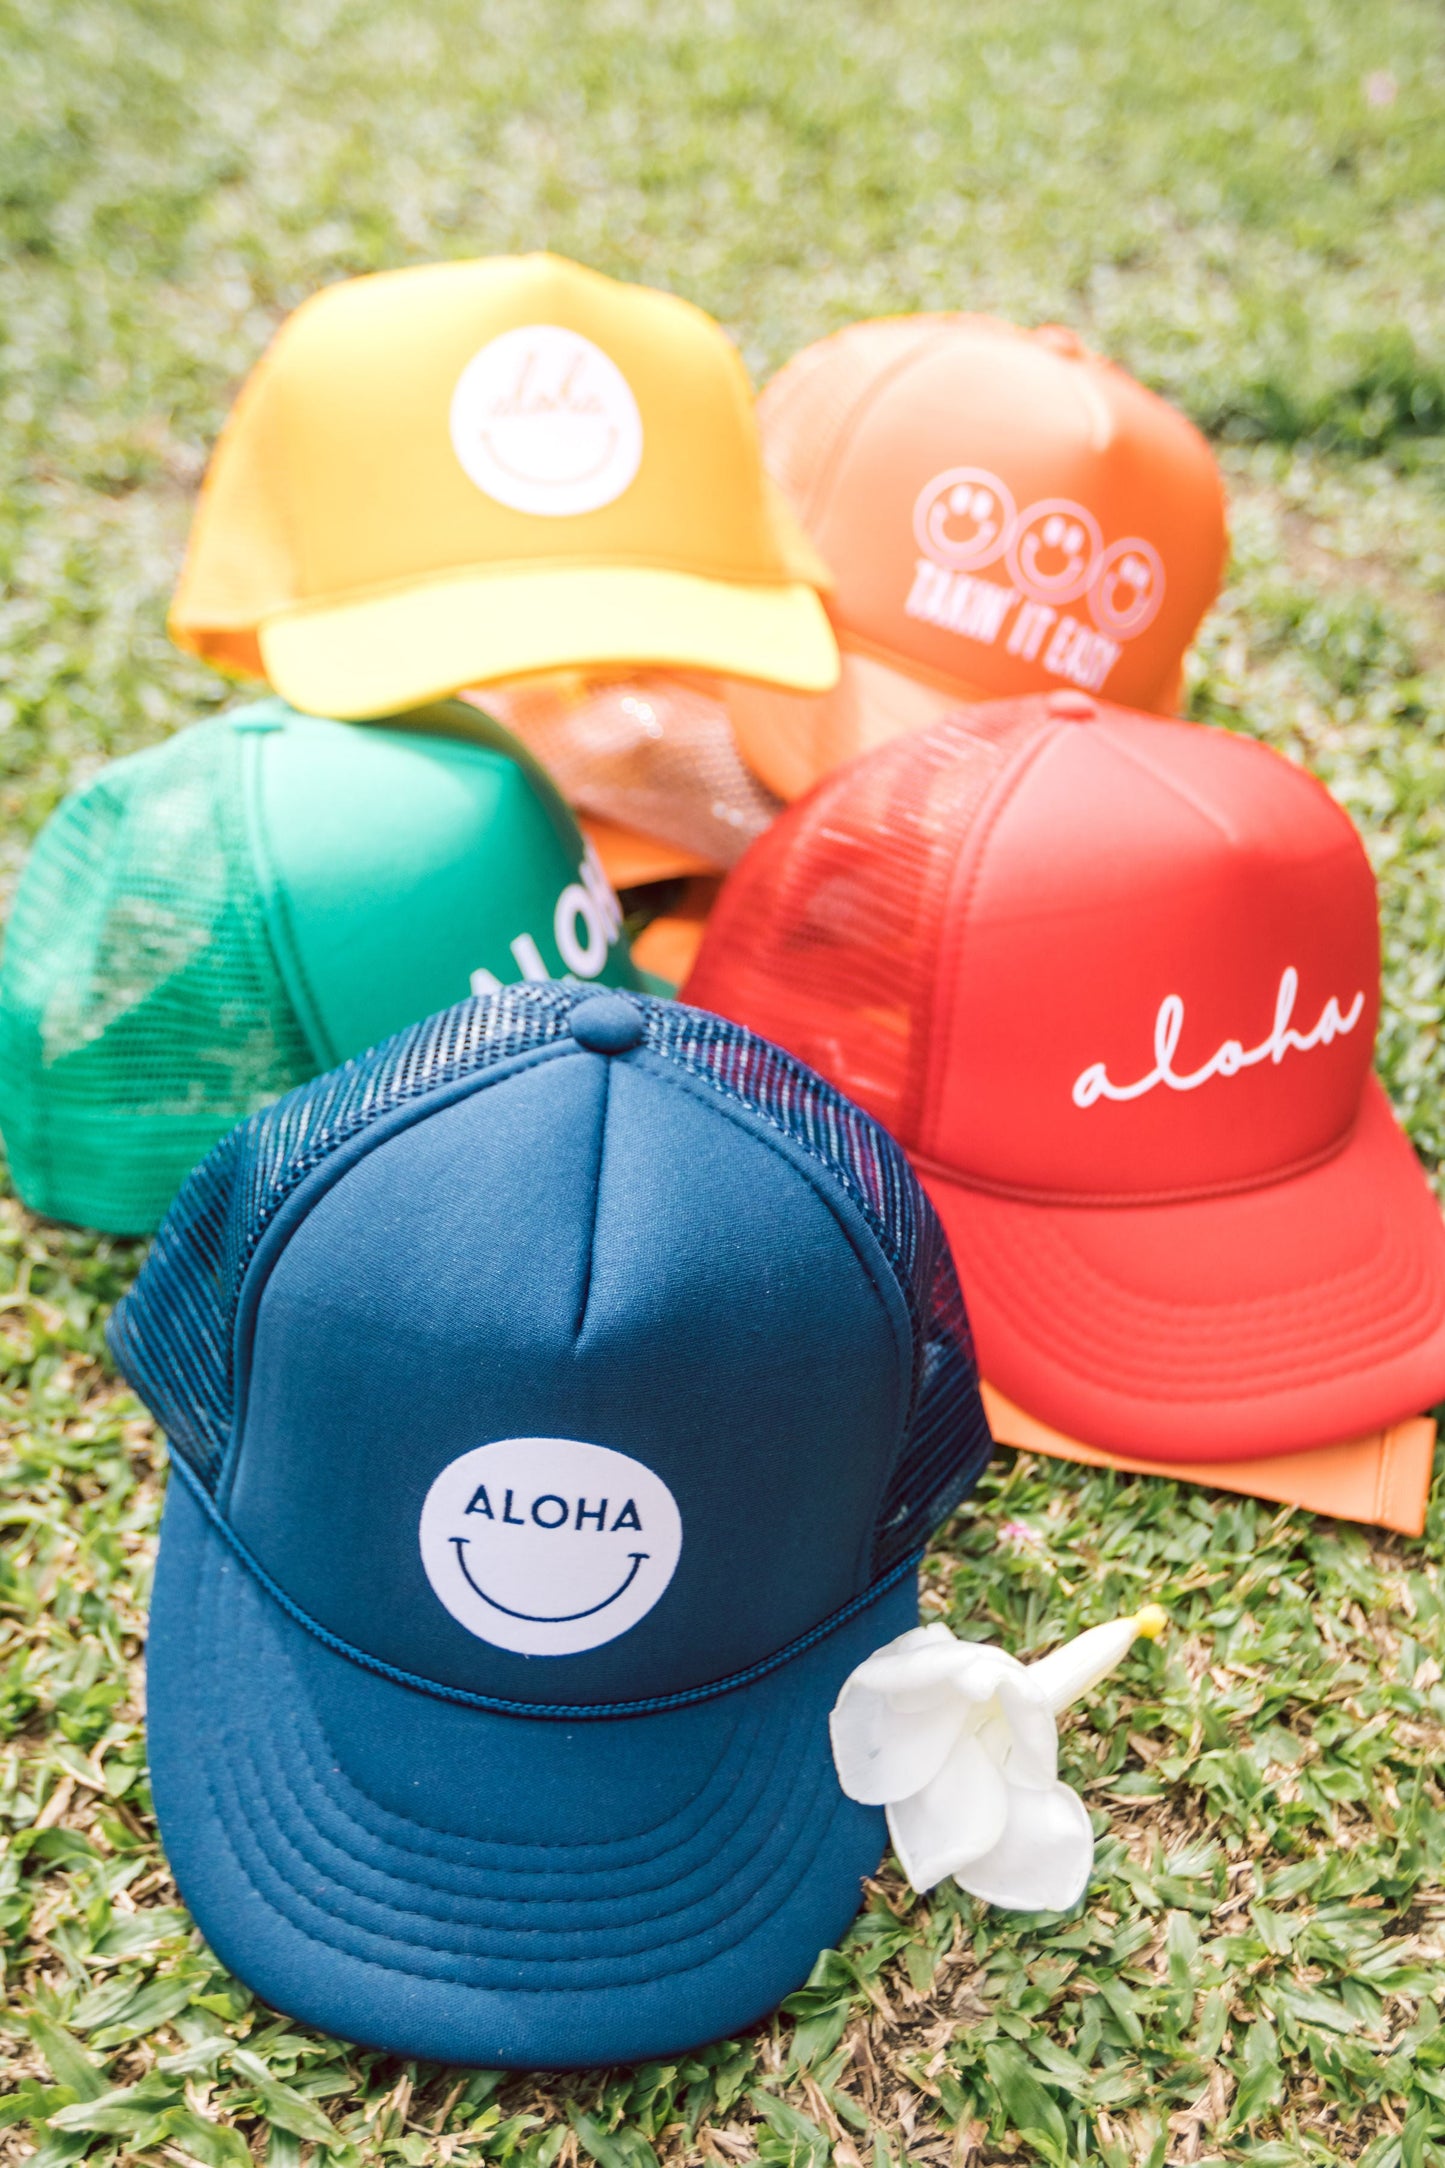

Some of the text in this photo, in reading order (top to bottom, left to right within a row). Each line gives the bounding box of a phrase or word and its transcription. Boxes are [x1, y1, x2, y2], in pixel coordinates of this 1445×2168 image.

[1005, 598, 1057, 663] IT
[1072, 966, 1364, 1108] aloha
[464, 1484, 643, 1532] ALOHA
